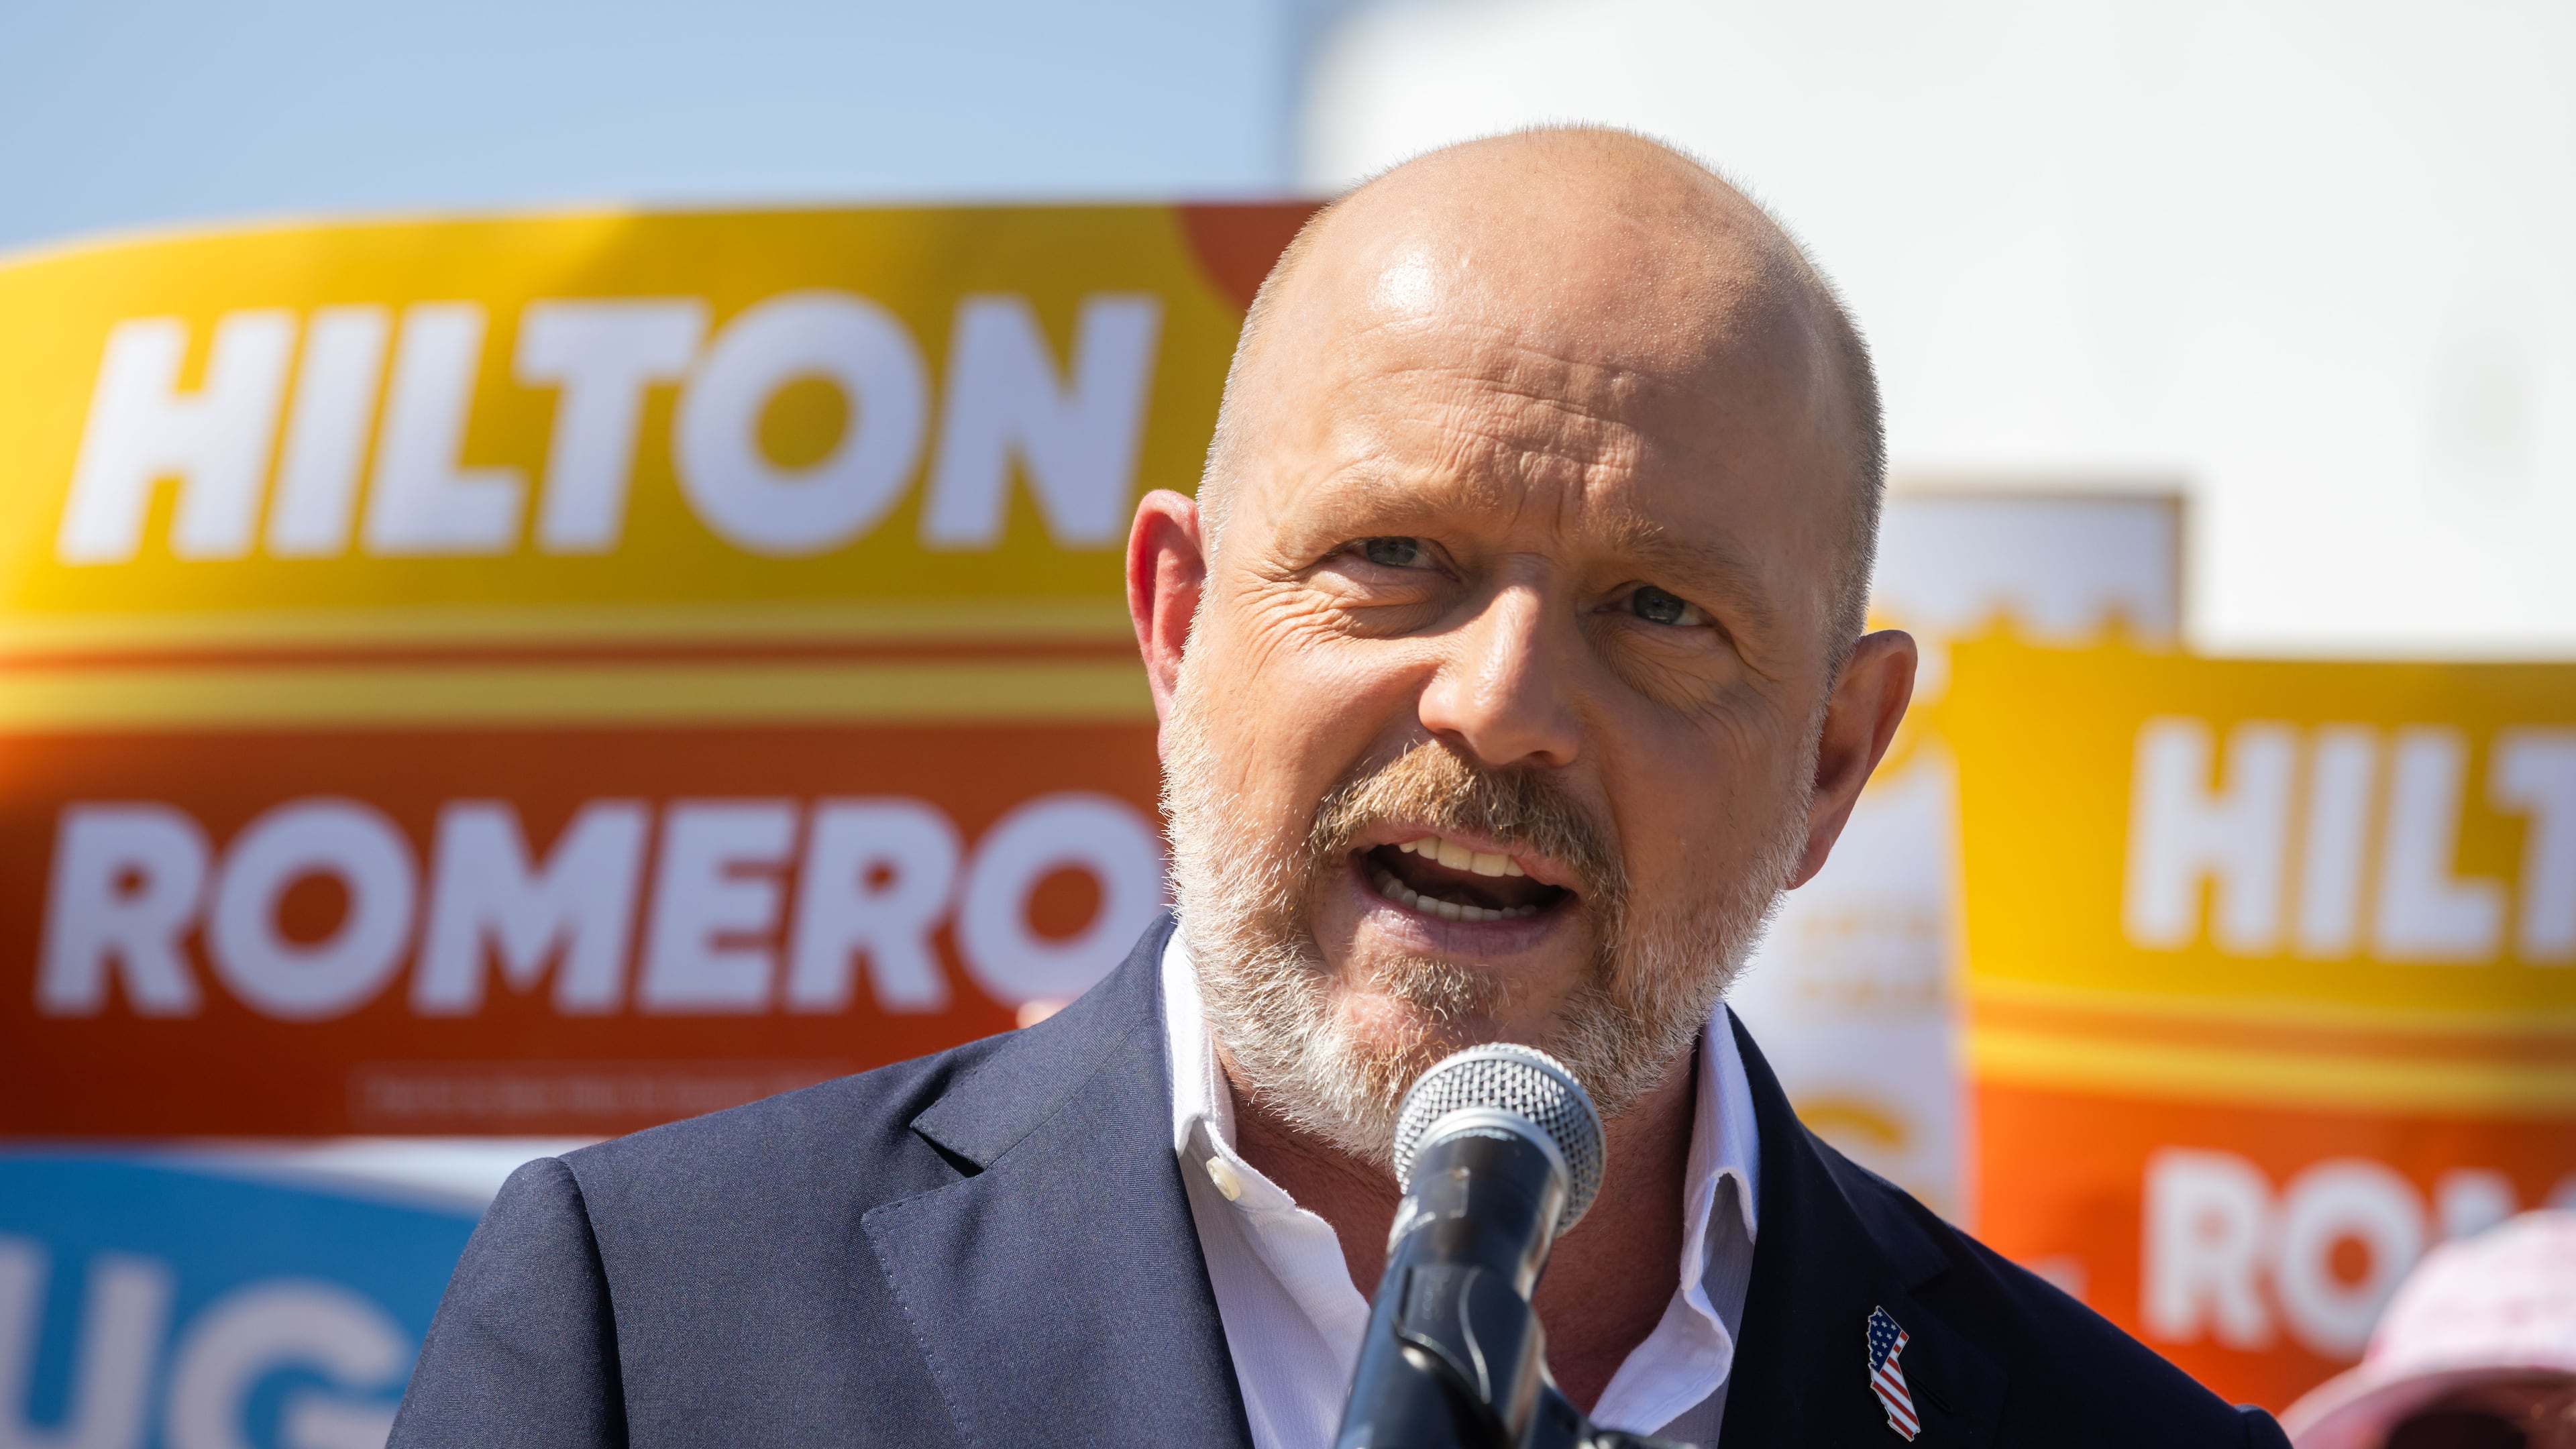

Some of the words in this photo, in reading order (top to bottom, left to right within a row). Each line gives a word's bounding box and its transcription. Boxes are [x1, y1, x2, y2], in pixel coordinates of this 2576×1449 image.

[56, 289, 1162, 564] HILTON
[38, 793, 1166, 1020] ROMERO
[2141, 1146, 2576, 1356] RO
